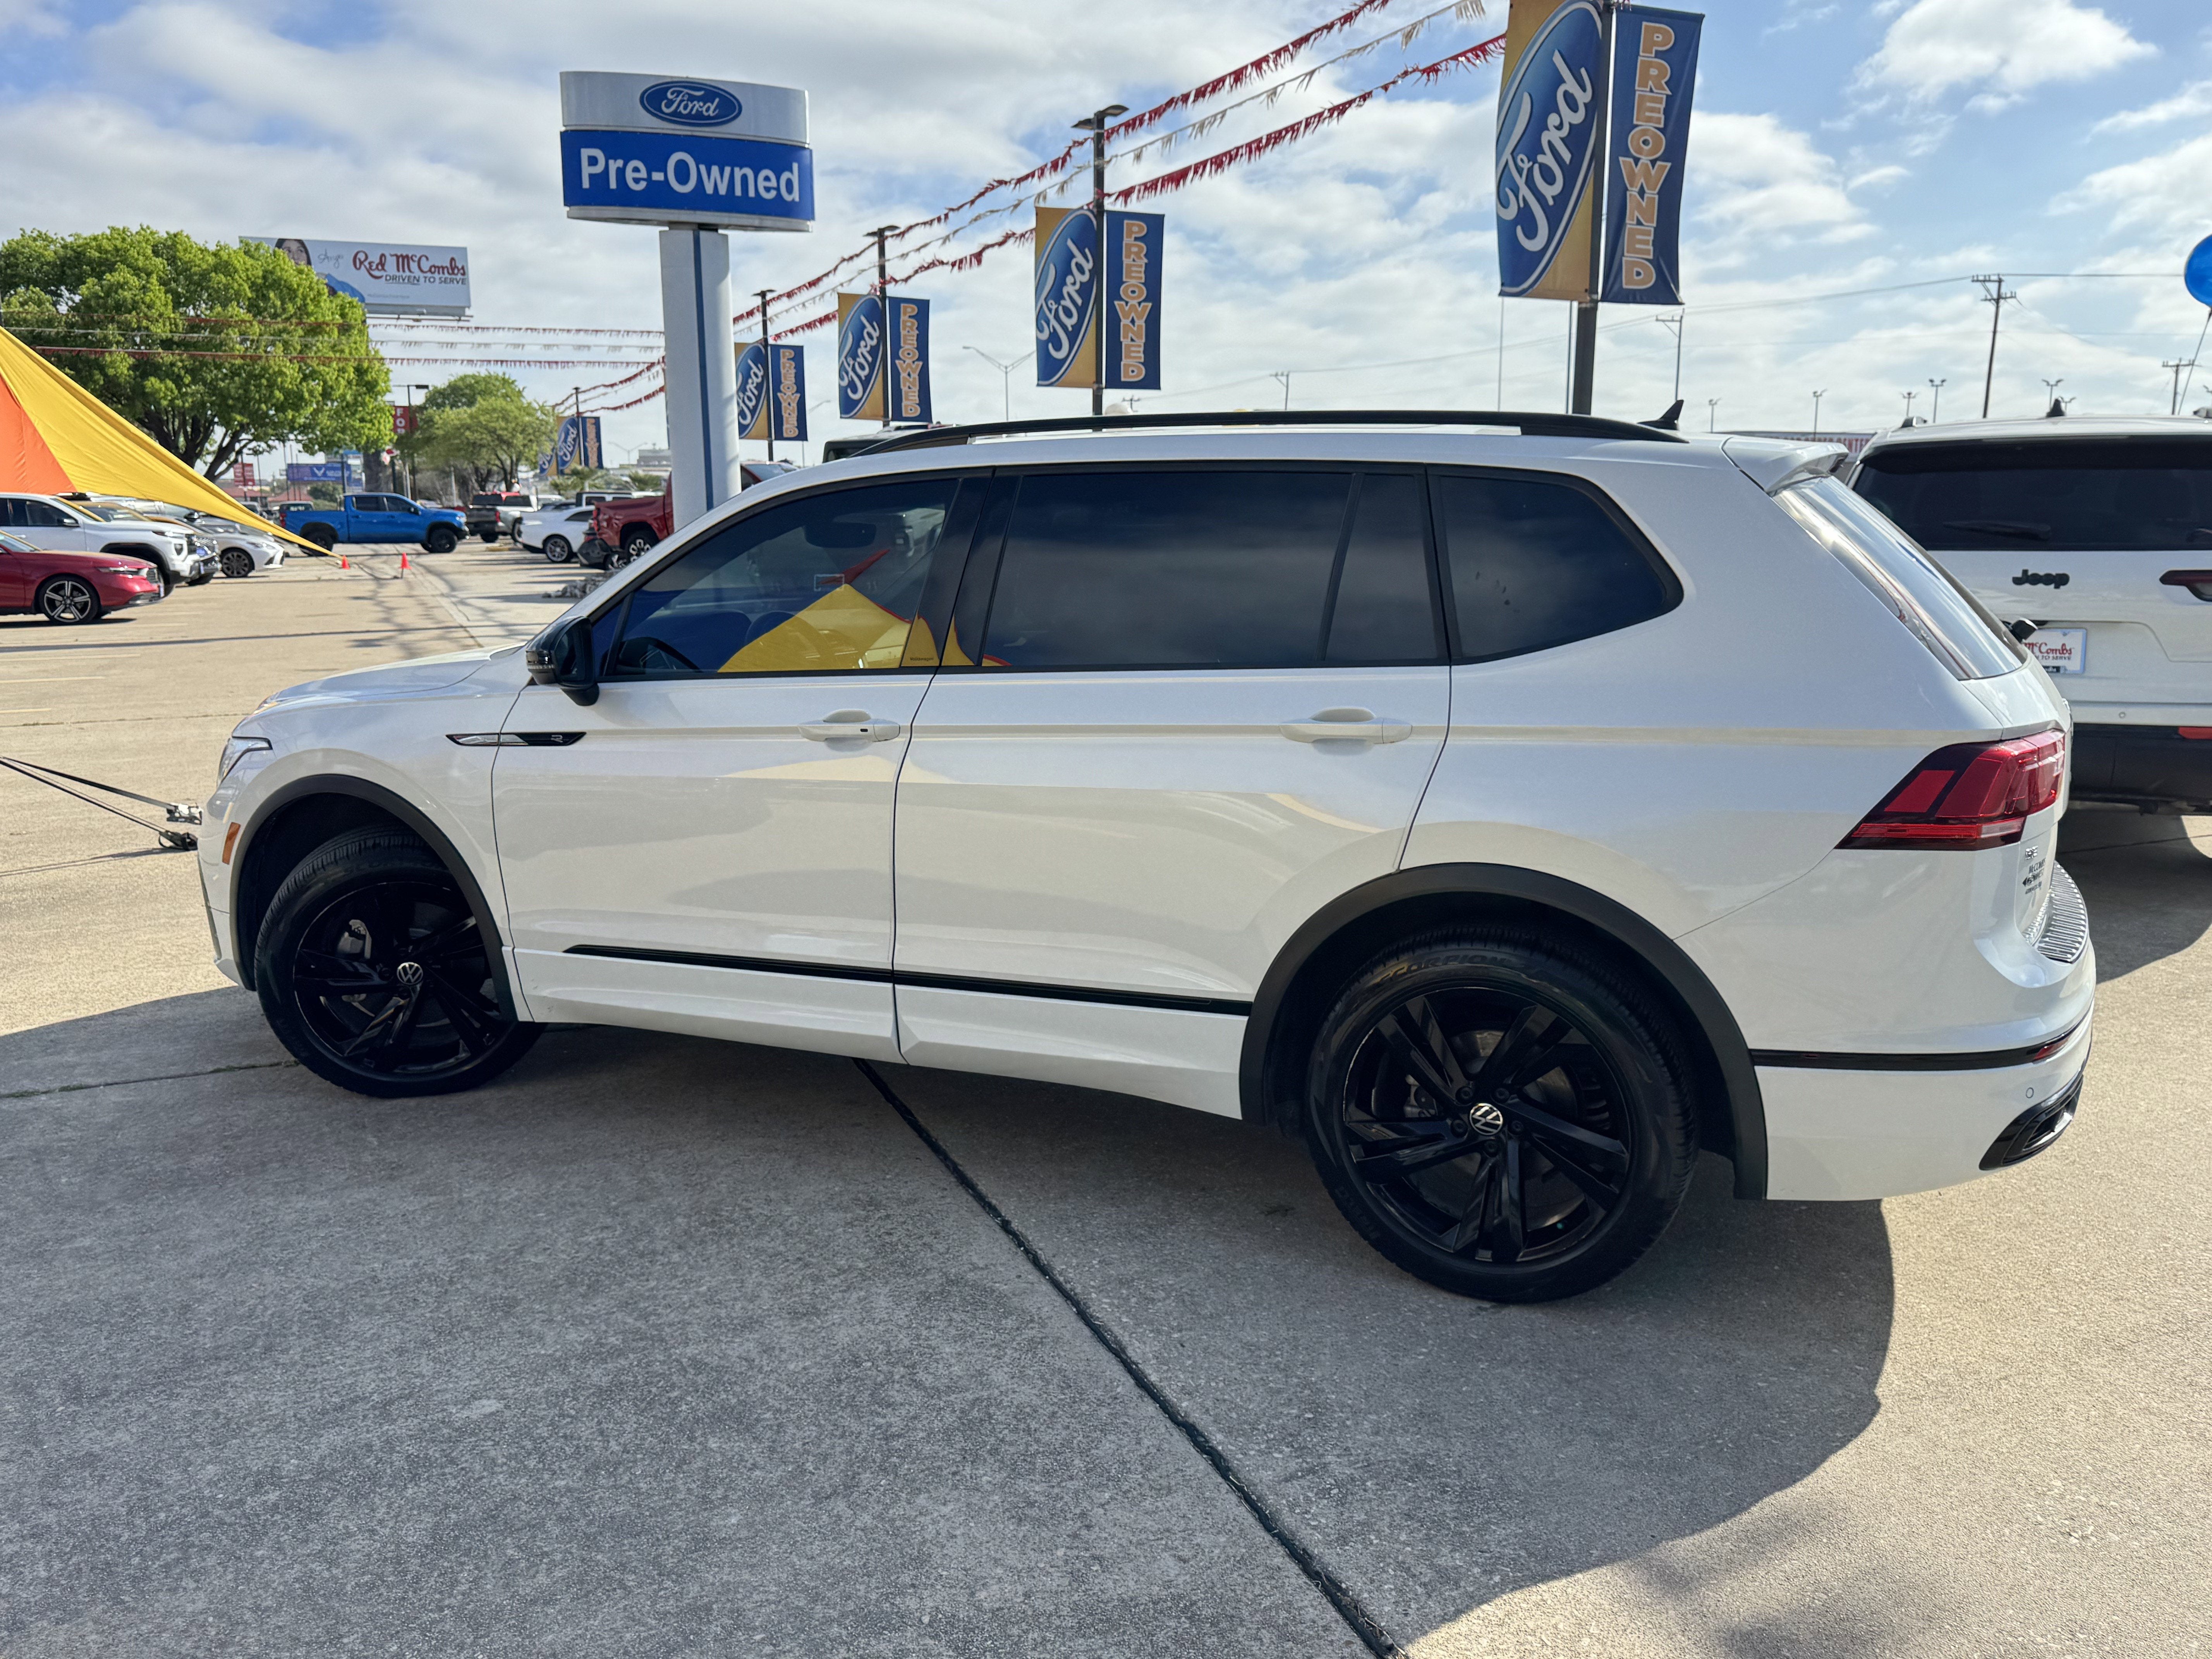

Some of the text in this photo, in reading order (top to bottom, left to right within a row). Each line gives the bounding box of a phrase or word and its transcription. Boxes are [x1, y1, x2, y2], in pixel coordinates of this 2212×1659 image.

[661, 87, 720, 117] Ford
[581, 148, 800, 202] Pre-Owned
[1497, 49, 1593, 252] Ford
[1619, 21, 1675, 290] PREOWNED
[352, 250, 386, 280] Red
[389, 252, 466, 276] McCombs
[385, 274, 467, 285] DRIVEN TO SERVE
[1036, 237, 1094, 360] Ford
[1113, 219, 1152, 381] PREOWNED
[736, 358, 764, 425] Ford
[777, 349, 800, 438] PREOWNED
[839, 314, 880, 400] Ford
[895, 303, 923, 417] PREOWNED
[2012, 568, 2070, 589] Jeep
